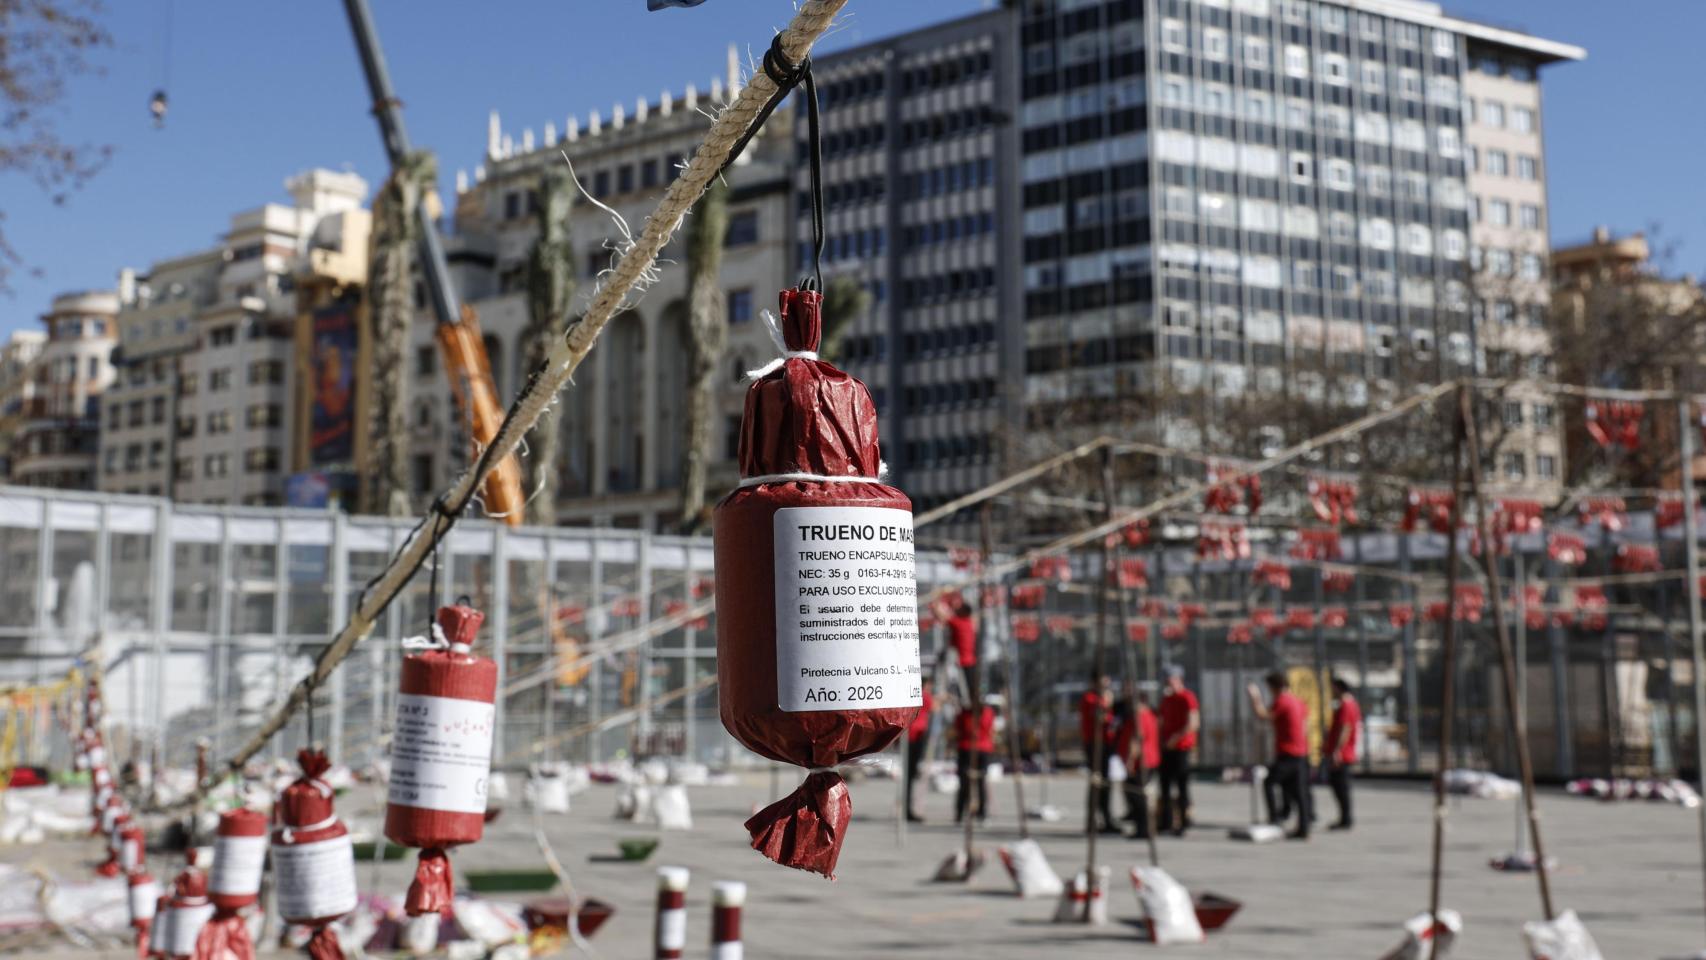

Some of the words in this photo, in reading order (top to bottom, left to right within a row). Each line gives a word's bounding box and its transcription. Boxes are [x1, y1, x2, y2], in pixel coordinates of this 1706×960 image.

[798, 525, 875, 541] TRUENO
[879, 525, 897, 541] DE
[798, 551, 846, 560] TRUENO
[849, 550, 908, 561] ENCAPSULADO
[798, 569, 826, 579] NEC:
[828, 568, 841, 578] 35
[843, 570, 850, 580] g
[857, 568, 907, 579] 0163-F4-2916
[799, 586, 829, 597] PARA
[832, 586, 856, 596] USO
[858, 586, 904, 596] EXCLUSIVO
[817, 603, 854, 614] usuario
[860, 603, 881, 613] debe
[799, 617, 868, 628] suministrados
[873, 617, 886, 626] del
[800, 631, 866, 642] instrucciones
[867, 630, 898, 640] escritas
[800, 667, 851, 678] Pirotecnia
[853, 665, 889, 676] Vulcano
[804, 687, 841, 702] Año:
[847, 685, 883, 701] 2026
